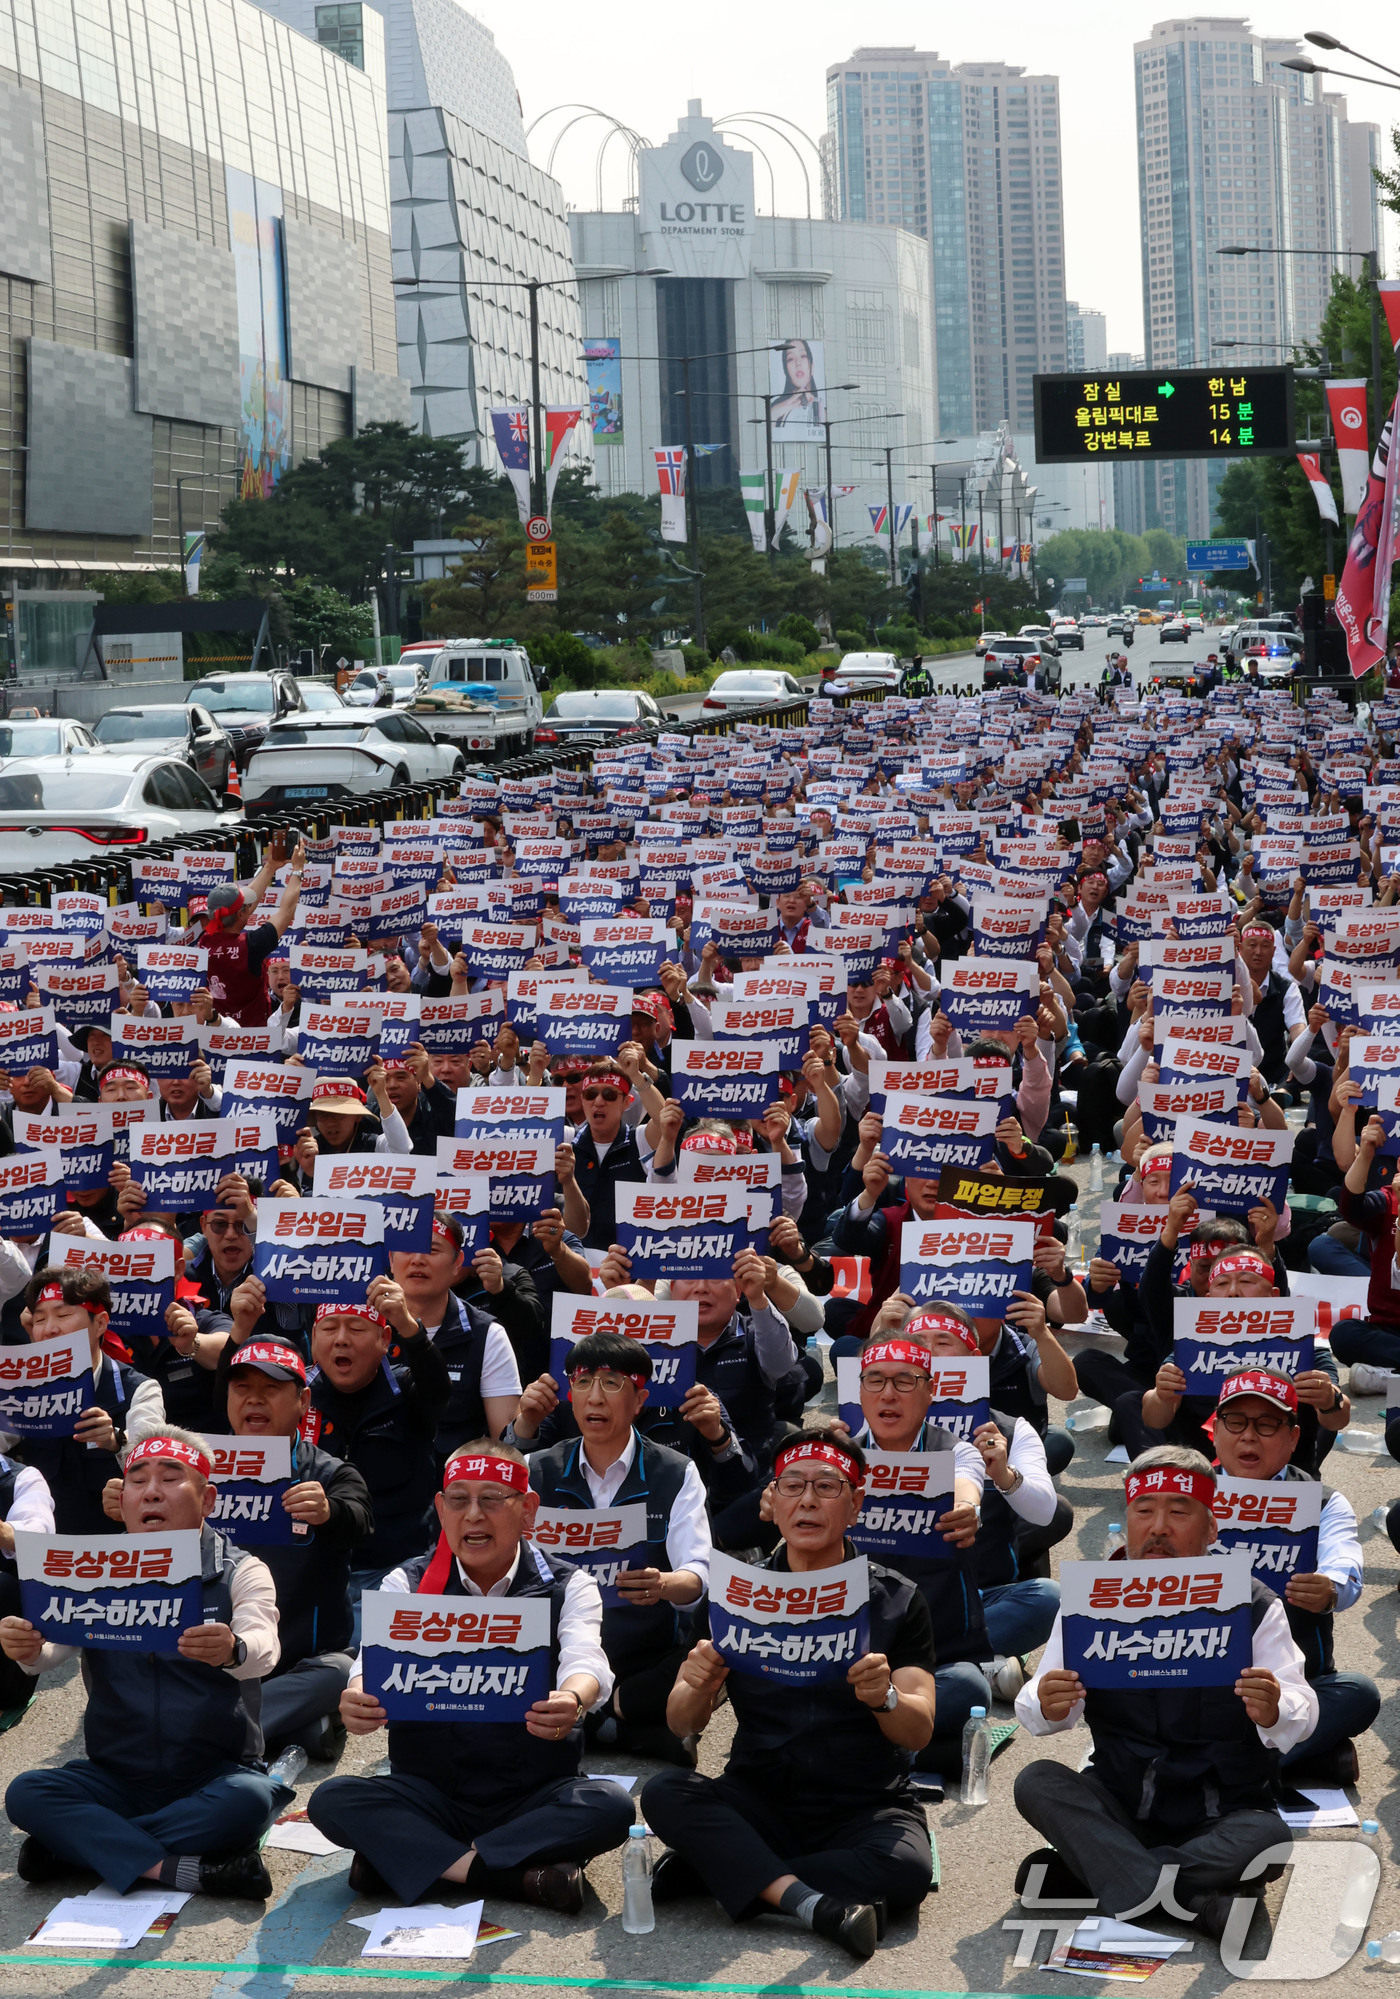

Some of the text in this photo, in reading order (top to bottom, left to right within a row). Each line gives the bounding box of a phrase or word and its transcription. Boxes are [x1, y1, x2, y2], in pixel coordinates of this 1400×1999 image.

[660, 203, 745, 223] LOTTE
[661, 227, 717, 236] DEPARTMENT
[1083, 377, 1246, 401] 잠실 한남
[1075, 402, 1253, 427] 올림픽대로 15 분
[808, 429, 825, 437] DIOR
[1084, 427, 1254, 451] 강변북로 14 분
[532, 523, 548, 535] 50
[530, 559, 552, 568] 단속중
[529, 592, 554, 600] 500m
[927, 769, 961, 778] 사수하자!
[1166, 803, 1195, 812] 통상임금
[940, 822, 972, 832] 통상임금
[1166, 816, 1198, 826] 사수하자!
[1311, 819, 1343, 830] 통상임금
[392, 850, 434, 861] 통상임금
[524, 846, 562, 856] 통상임금
[648, 853, 686, 863] 통상임금
[1309, 848, 1351, 862] 통상임금
[518, 863, 564, 873] 사수하자!
[884, 858, 925, 870] 통상임금
[1019, 856, 1060, 866] 통상임금
[142, 866, 179, 879] 통상임금
[644, 870, 692, 880] 사수하자!
[753, 873, 796, 885] 사수하자!
[1154, 869, 1193, 882] 통상임금
[1307, 865, 1354, 877] 사수하자!
[140, 884, 181, 897] 사수하자!
[342, 880, 384, 895] 통상임금
[568, 883, 612, 895] 통상임금
[854, 886, 895, 901] 통상임금
[381, 891, 419, 912] 통상임금
[436, 898, 478, 910] 통상임금
[566, 901, 616, 913] 사수하자!
[1177, 900, 1222, 914] 통상임금
[1320, 894, 1363, 906] 통상임금
[377, 910, 424, 930] 사수하자!
[719, 917, 768, 931] 통상임금
[840, 912, 888, 926] 통상임금
[982, 917, 1030, 933] 통상임금
[112, 921, 157, 935] 통상임금
[594, 927, 652, 941] 통상임금
[472, 930, 524, 946] 통상임금
[717, 935, 772, 948] 사수하자!
[825, 936, 872, 949] 통상임금
[979, 938, 1032, 954] 사수하자!
[1163, 946, 1222, 962] 통상임금
[1335, 939, 1390, 954] 통상임금
[147, 953, 198, 967] 통상임금
[301, 954, 355, 968] 통상임금
[469, 952, 525, 969] 사수하자!
[591, 950, 657, 966] 사수하자!
[48, 975, 105, 991] 통상임금
[143, 975, 203, 990] 사수하자!
[298, 976, 359, 990] 사수하자!
[953, 971, 1017, 988] 통상임금
[745, 980, 807, 996] 통상임금
[1163, 979, 1221, 997] 통상임금
[550, 994, 617, 1011] 통상임금
[948, 998, 1021, 1016] 사수하자!
[308, 1014, 369, 1033] 통상임금
[726, 1008, 793, 1028] 통상임금
[123, 1024, 183, 1041] 통상임금
[545, 1022, 620, 1041] 사수하자!
[209, 1035, 269, 1050] 통상임금
[297, 1042, 371, 1062] 사수하자!
[687, 1051, 763, 1069] 통상임금
[1174, 1049, 1239, 1073] 통상임금
[234, 1071, 301, 1094] 통상임금
[884, 1069, 959, 1090] 통상임금
[681, 1083, 767, 1102] 사수하자!
[472, 1097, 548, 1114] 통상임금
[1154, 1091, 1224, 1112] 통상임금
[899, 1106, 979, 1131] 통상임금
[27, 1124, 96, 1143] 통상임금
[142, 1133, 216, 1155] 통상임금
[889, 1139, 981, 1165] 사수하자!
[1189, 1131, 1275, 1161] 통상임금
[454, 1150, 537, 1170] 통상임금
[141, 1168, 222, 1193] 사수하자!
[329, 1166, 416, 1190] 통상임금
[1179, 1167, 1275, 1197] 사수하자!
[953, 1179, 1045, 1211] 파업투쟁
[633, 1195, 727, 1219] 통상임금
[275, 1212, 366, 1237] 통상임금
[628, 1234, 733, 1259] 사수하자!
[919, 1233, 1013, 1256] 통상임금
[64, 1249, 155, 1276] 통상임금
[261, 1254, 372, 1282] 사수하자!
[912, 1273, 1017, 1297] 사수하자!
[572, 1310, 675, 1339] 통상임금
[1196, 1311, 1294, 1334] 통상임금
[1256, 1376, 1288, 1400] 투쟁
[170, 1440, 199, 1465] 투쟁
[43, 1549, 172, 1578] 통상임금
[727, 1576, 847, 1614] 통상임금
[1090, 1574, 1222, 1608] 통상임금
[41, 1597, 182, 1627] 사수하자!
[390, 1611, 521, 1643] 통상임금
[94, 1633, 142, 1641] 서울시버스노동조합
[719, 1625, 856, 1662] 사수하자!
[1083, 1626, 1231, 1661] 사수하자!
[381, 1663, 528, 1695] 사수하자!
[769, 1666, 817, 1677] 서울시버스노동조합
[1137, 1668, 1188, 1677] 서울시버스노동조합
[435, 1702, 485, 1711] 서울시버스노동조합
